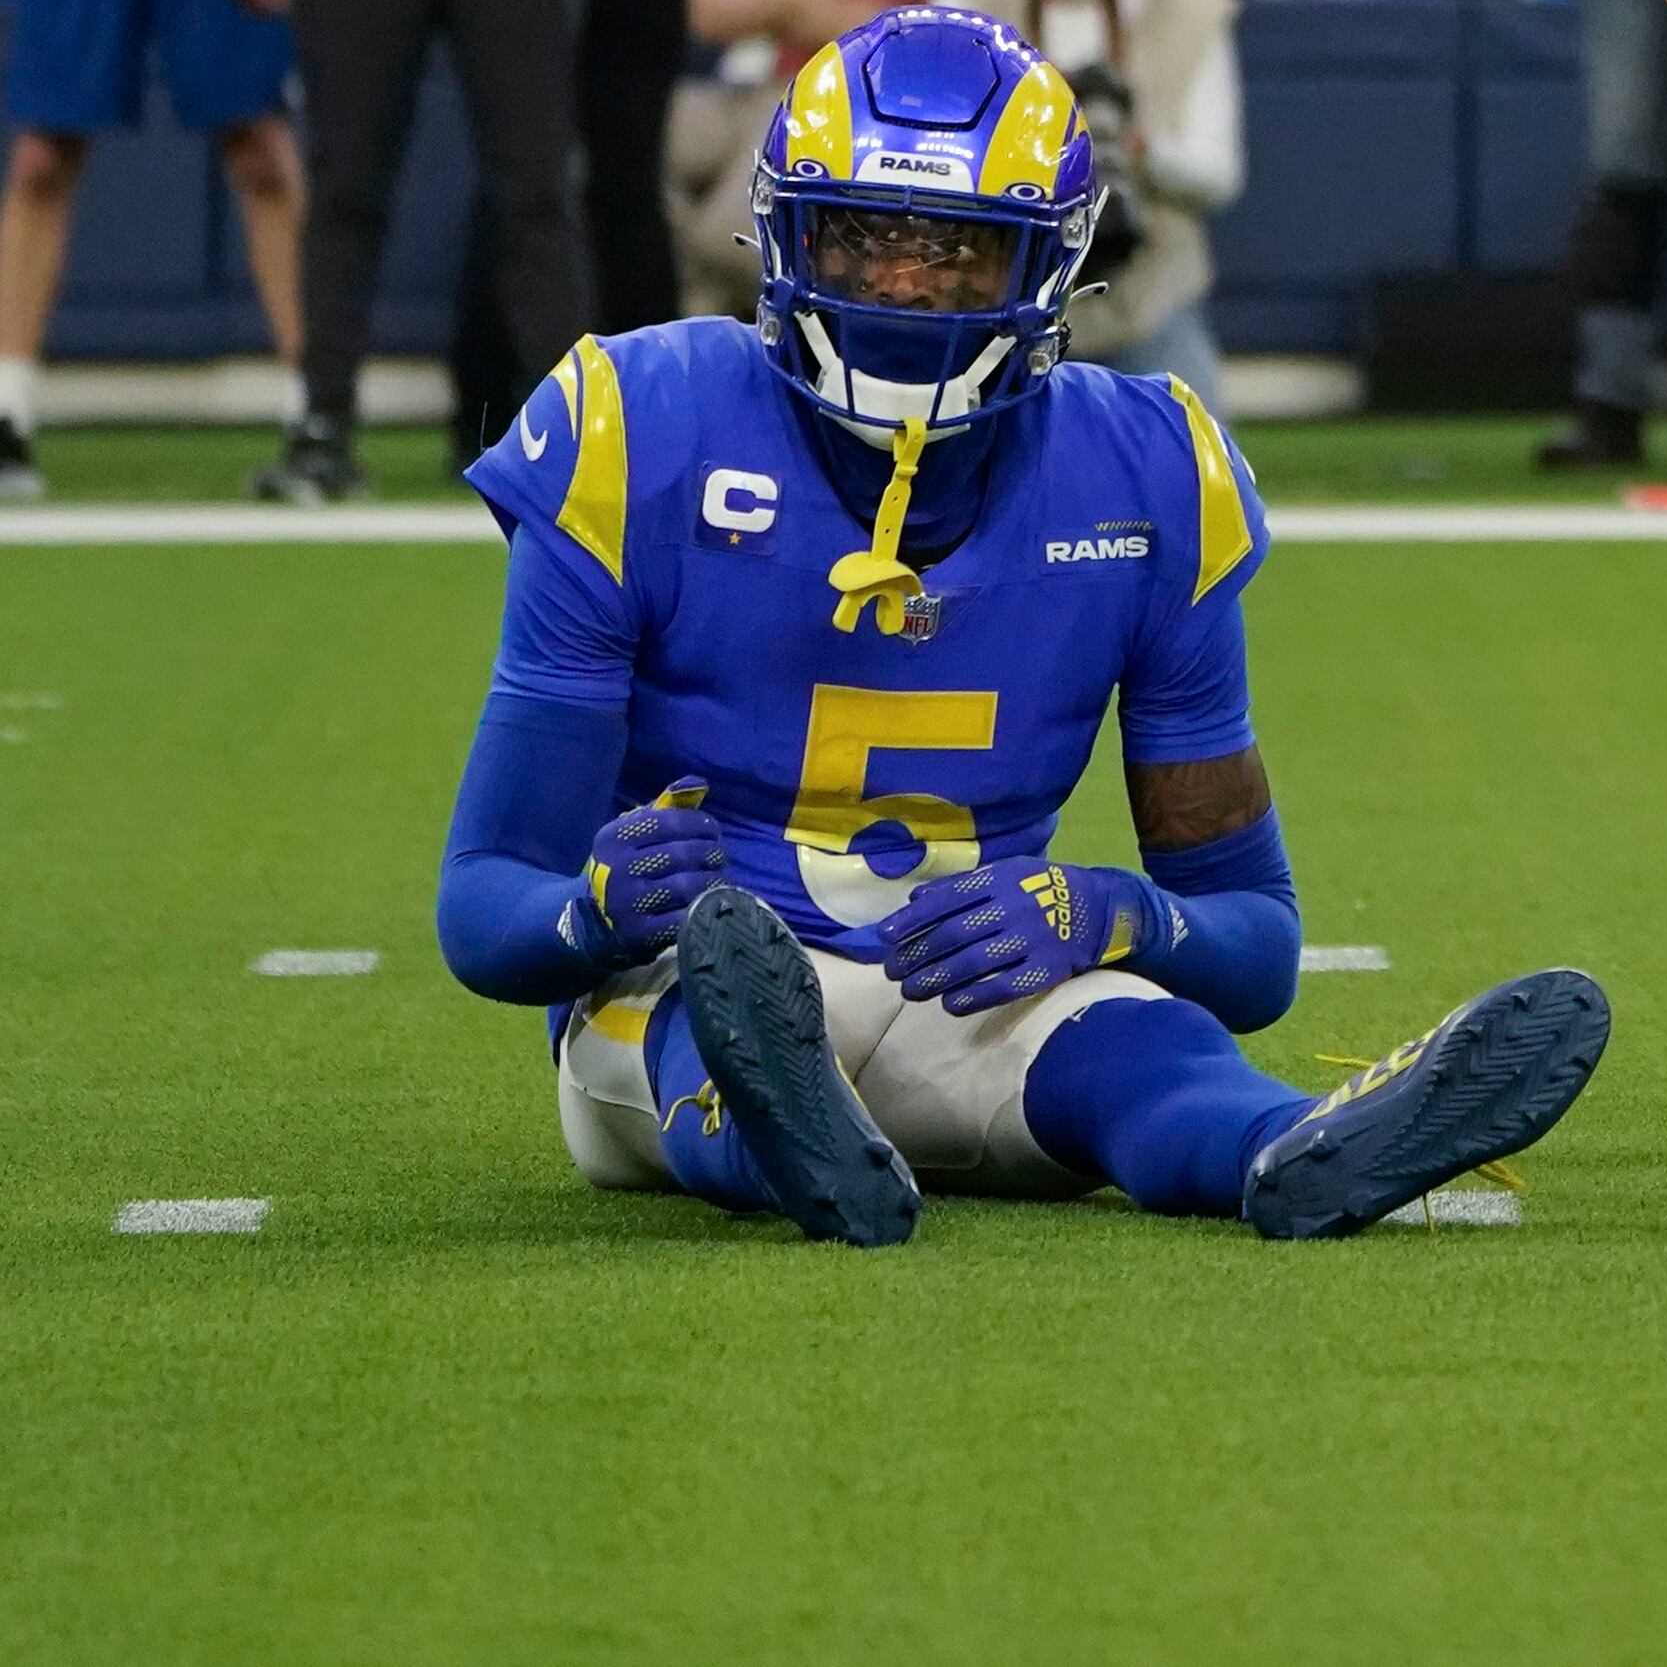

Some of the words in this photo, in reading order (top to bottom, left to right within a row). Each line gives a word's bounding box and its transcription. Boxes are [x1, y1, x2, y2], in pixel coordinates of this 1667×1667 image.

[880, 157, 951, 176] RAMS
[702, 468, 778, 533] C
[1045, 536, 1149, 564] RAMS
[904, 613, 932, 634] NFL
[783, 683, 998, 930] 5
[1049, 865, 1071, 942] adidas
